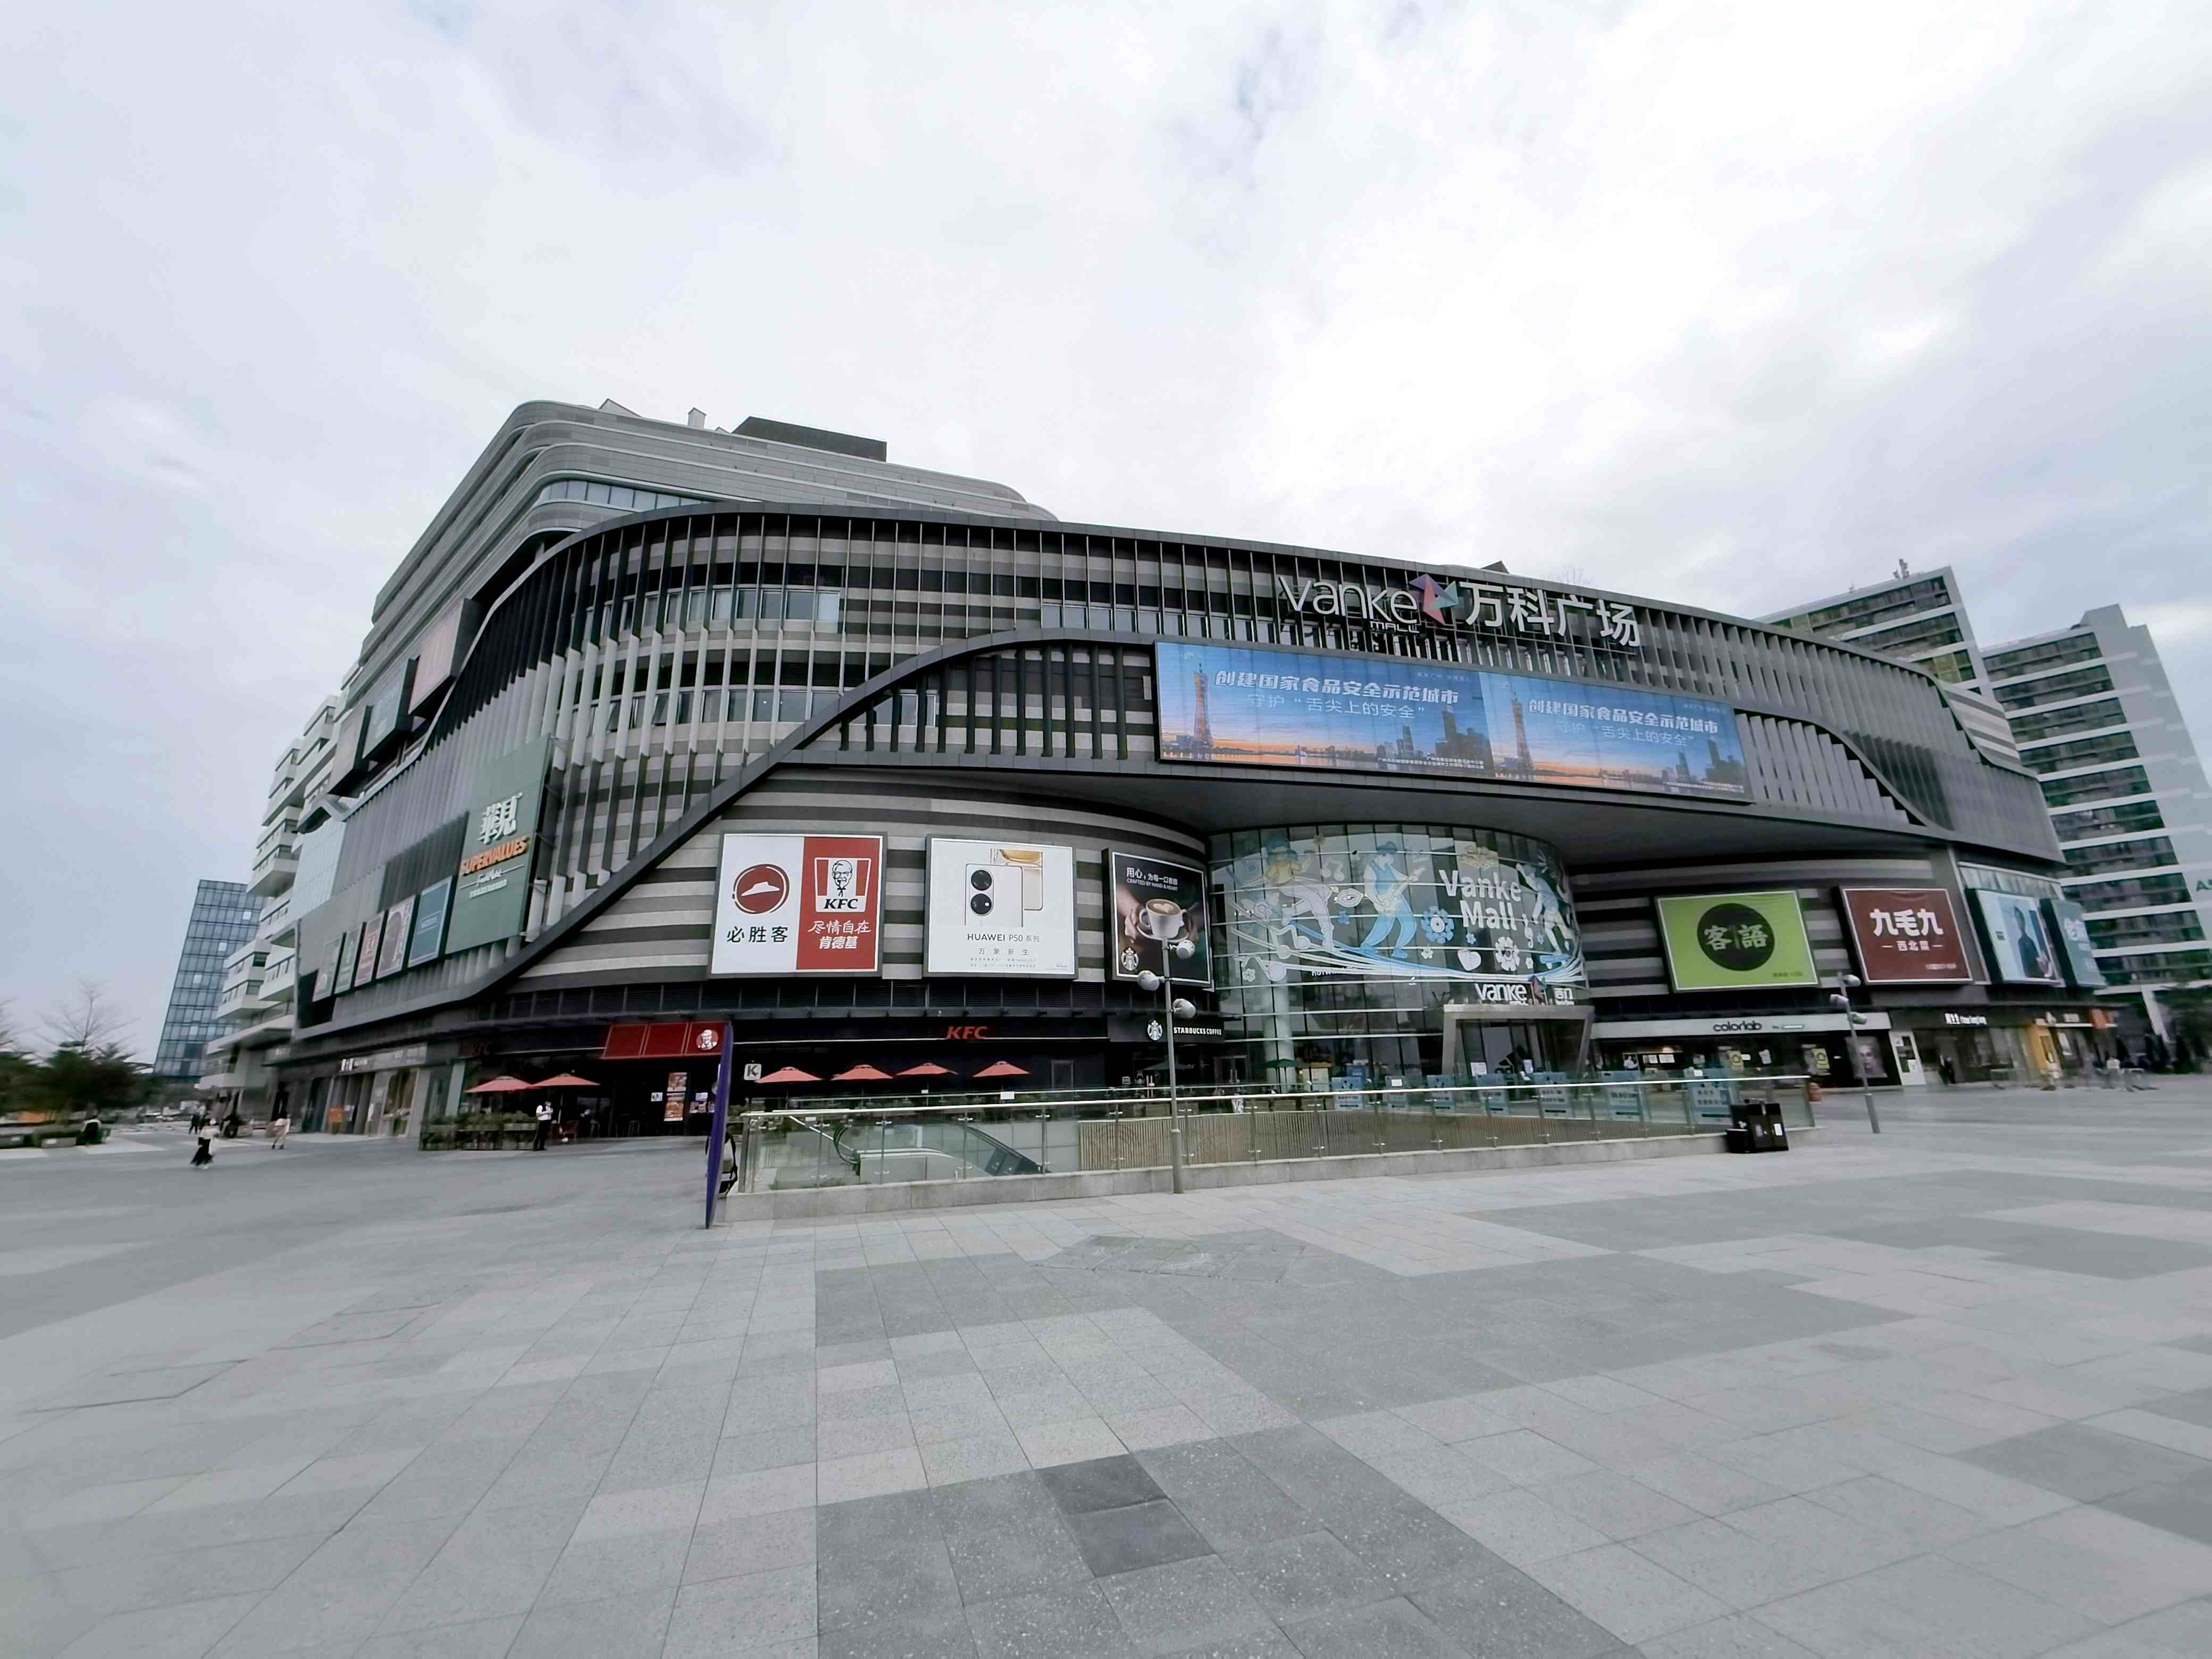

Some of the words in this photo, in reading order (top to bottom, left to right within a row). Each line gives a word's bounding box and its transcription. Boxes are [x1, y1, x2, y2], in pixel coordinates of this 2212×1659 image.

[1459, 581, 1641, 647] 万科广场
[1215, 670, 1459, 705] 创建国家食品安全示范城市
[1528, 699, 1719, 734] 创建国家食品安全示范城市
[1438, 869, 1522, 902] Vanke
[823, 898, 859, 909] KFC
[1460, 900, 1517, 931] Mall
[1869, 908, 1945, 936] 九毛九
[726, 926, 789, 943] 必胜客
[808, 919, 872, 935] 尽情自在
[819, 935, 858, 949] 肯德基
[946, 1026, 988, 1040] KFC
[1173, 1027, 1205, 1035] STARBUCKS
[1713, 1020, 1762, 1032] colorlab
